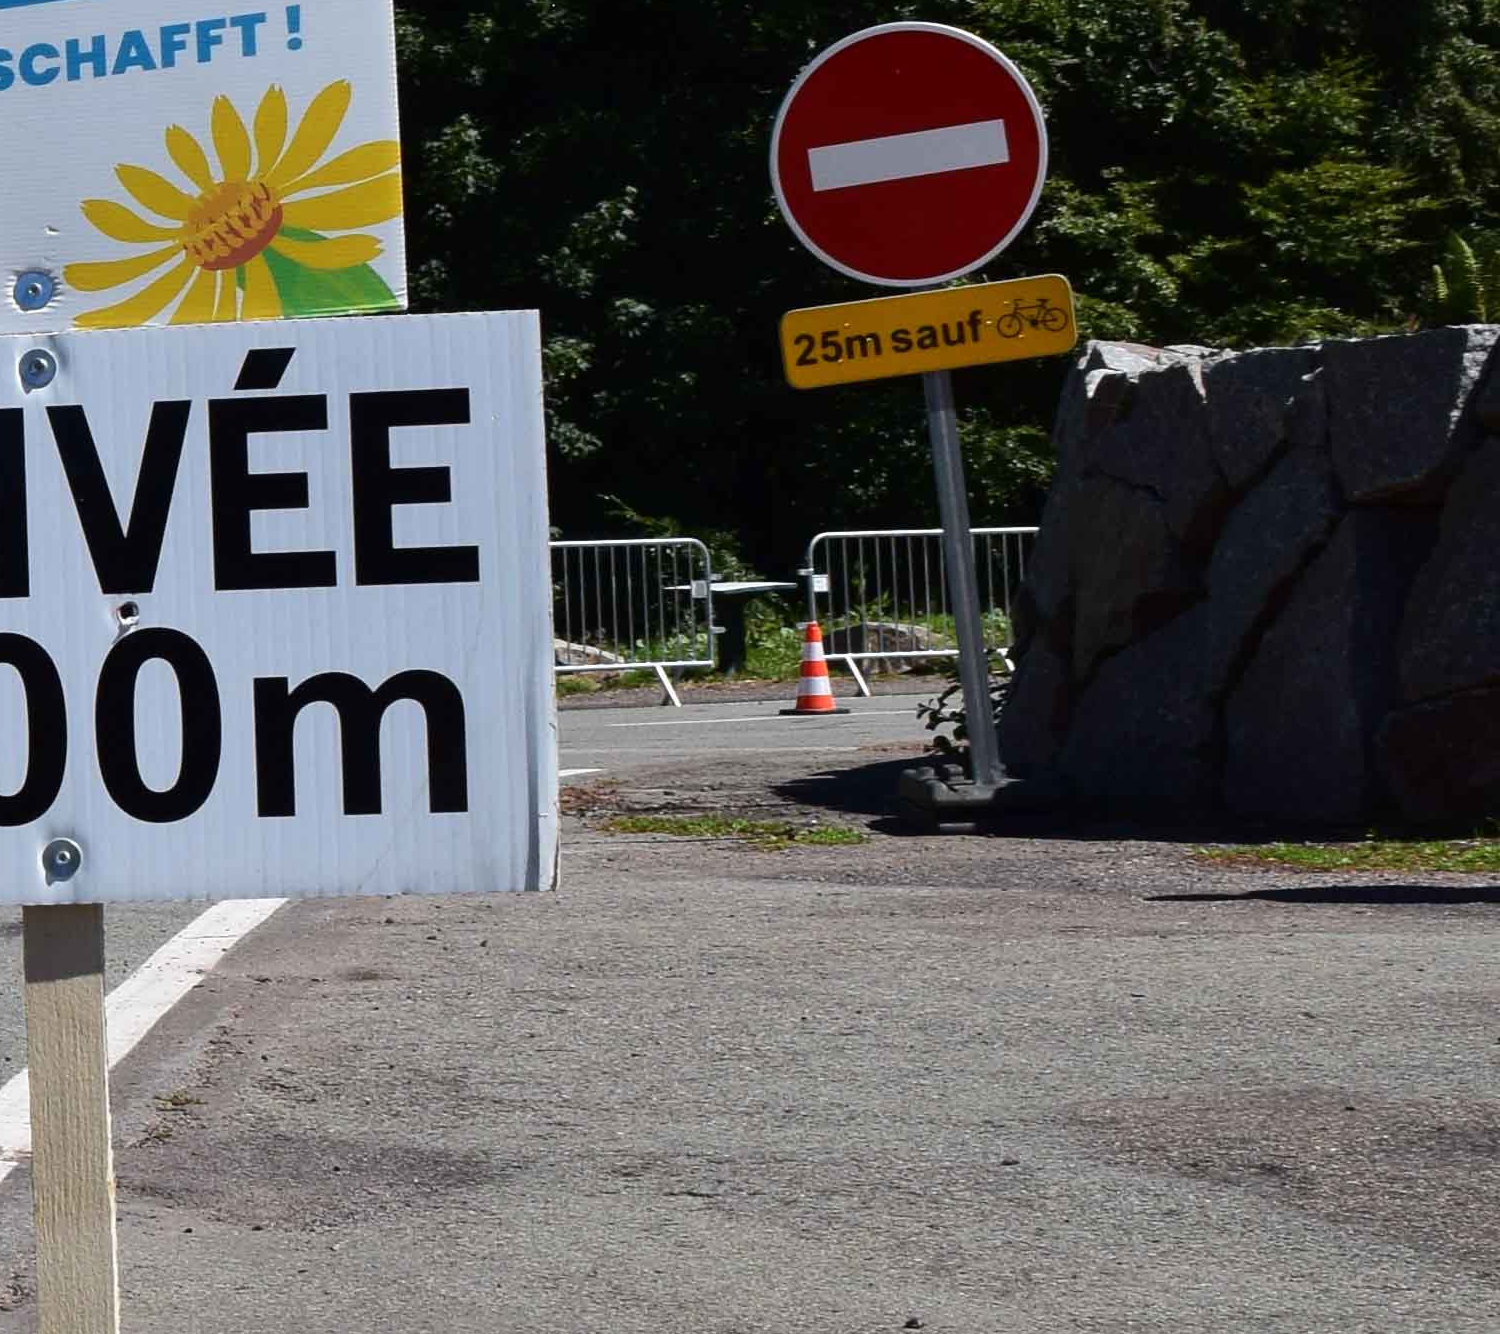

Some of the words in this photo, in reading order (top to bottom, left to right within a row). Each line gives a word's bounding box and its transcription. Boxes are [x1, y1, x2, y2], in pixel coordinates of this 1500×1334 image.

[284, 4, 303, 51] !
[793, 330, 883, 367] 25m
[891, 310, 983, 355] sauf
